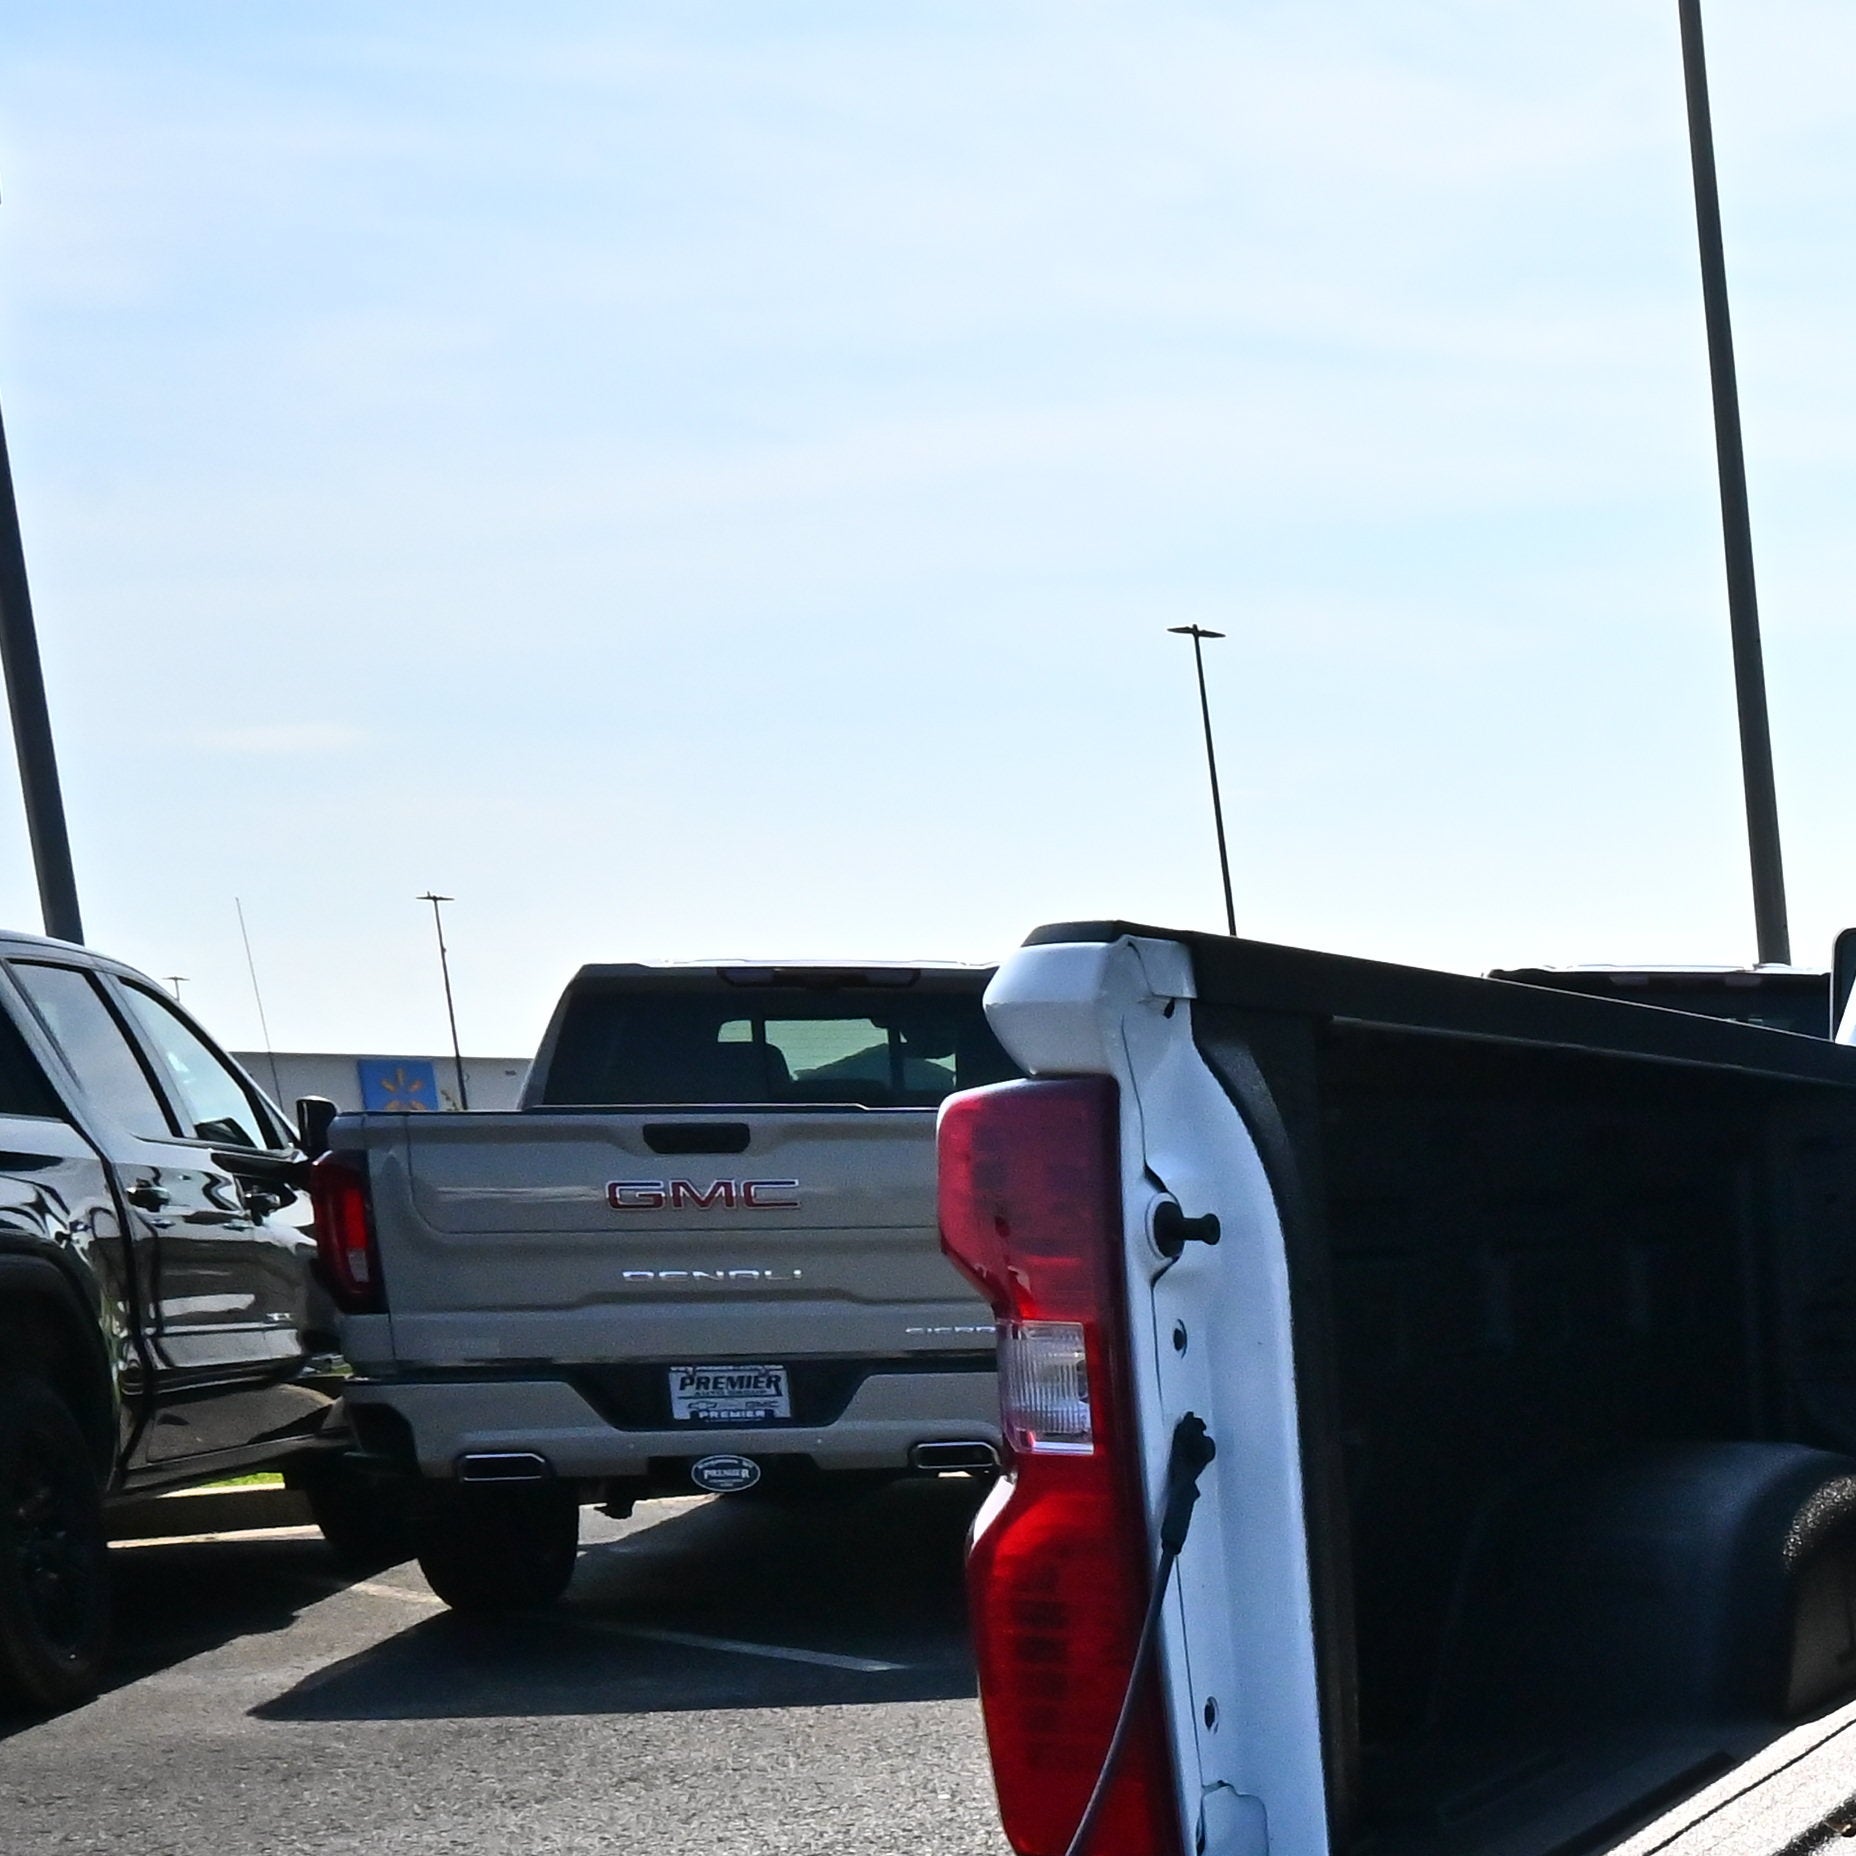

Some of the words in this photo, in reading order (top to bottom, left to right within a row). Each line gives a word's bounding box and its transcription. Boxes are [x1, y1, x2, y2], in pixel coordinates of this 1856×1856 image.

[605, 1179, 800, 1210] GMC
[622, 1269, 802, 1281] DENALI
[679, 1374, 783, 1397] PREMIER
[699, 1409, 765, 1419] PREMIER
